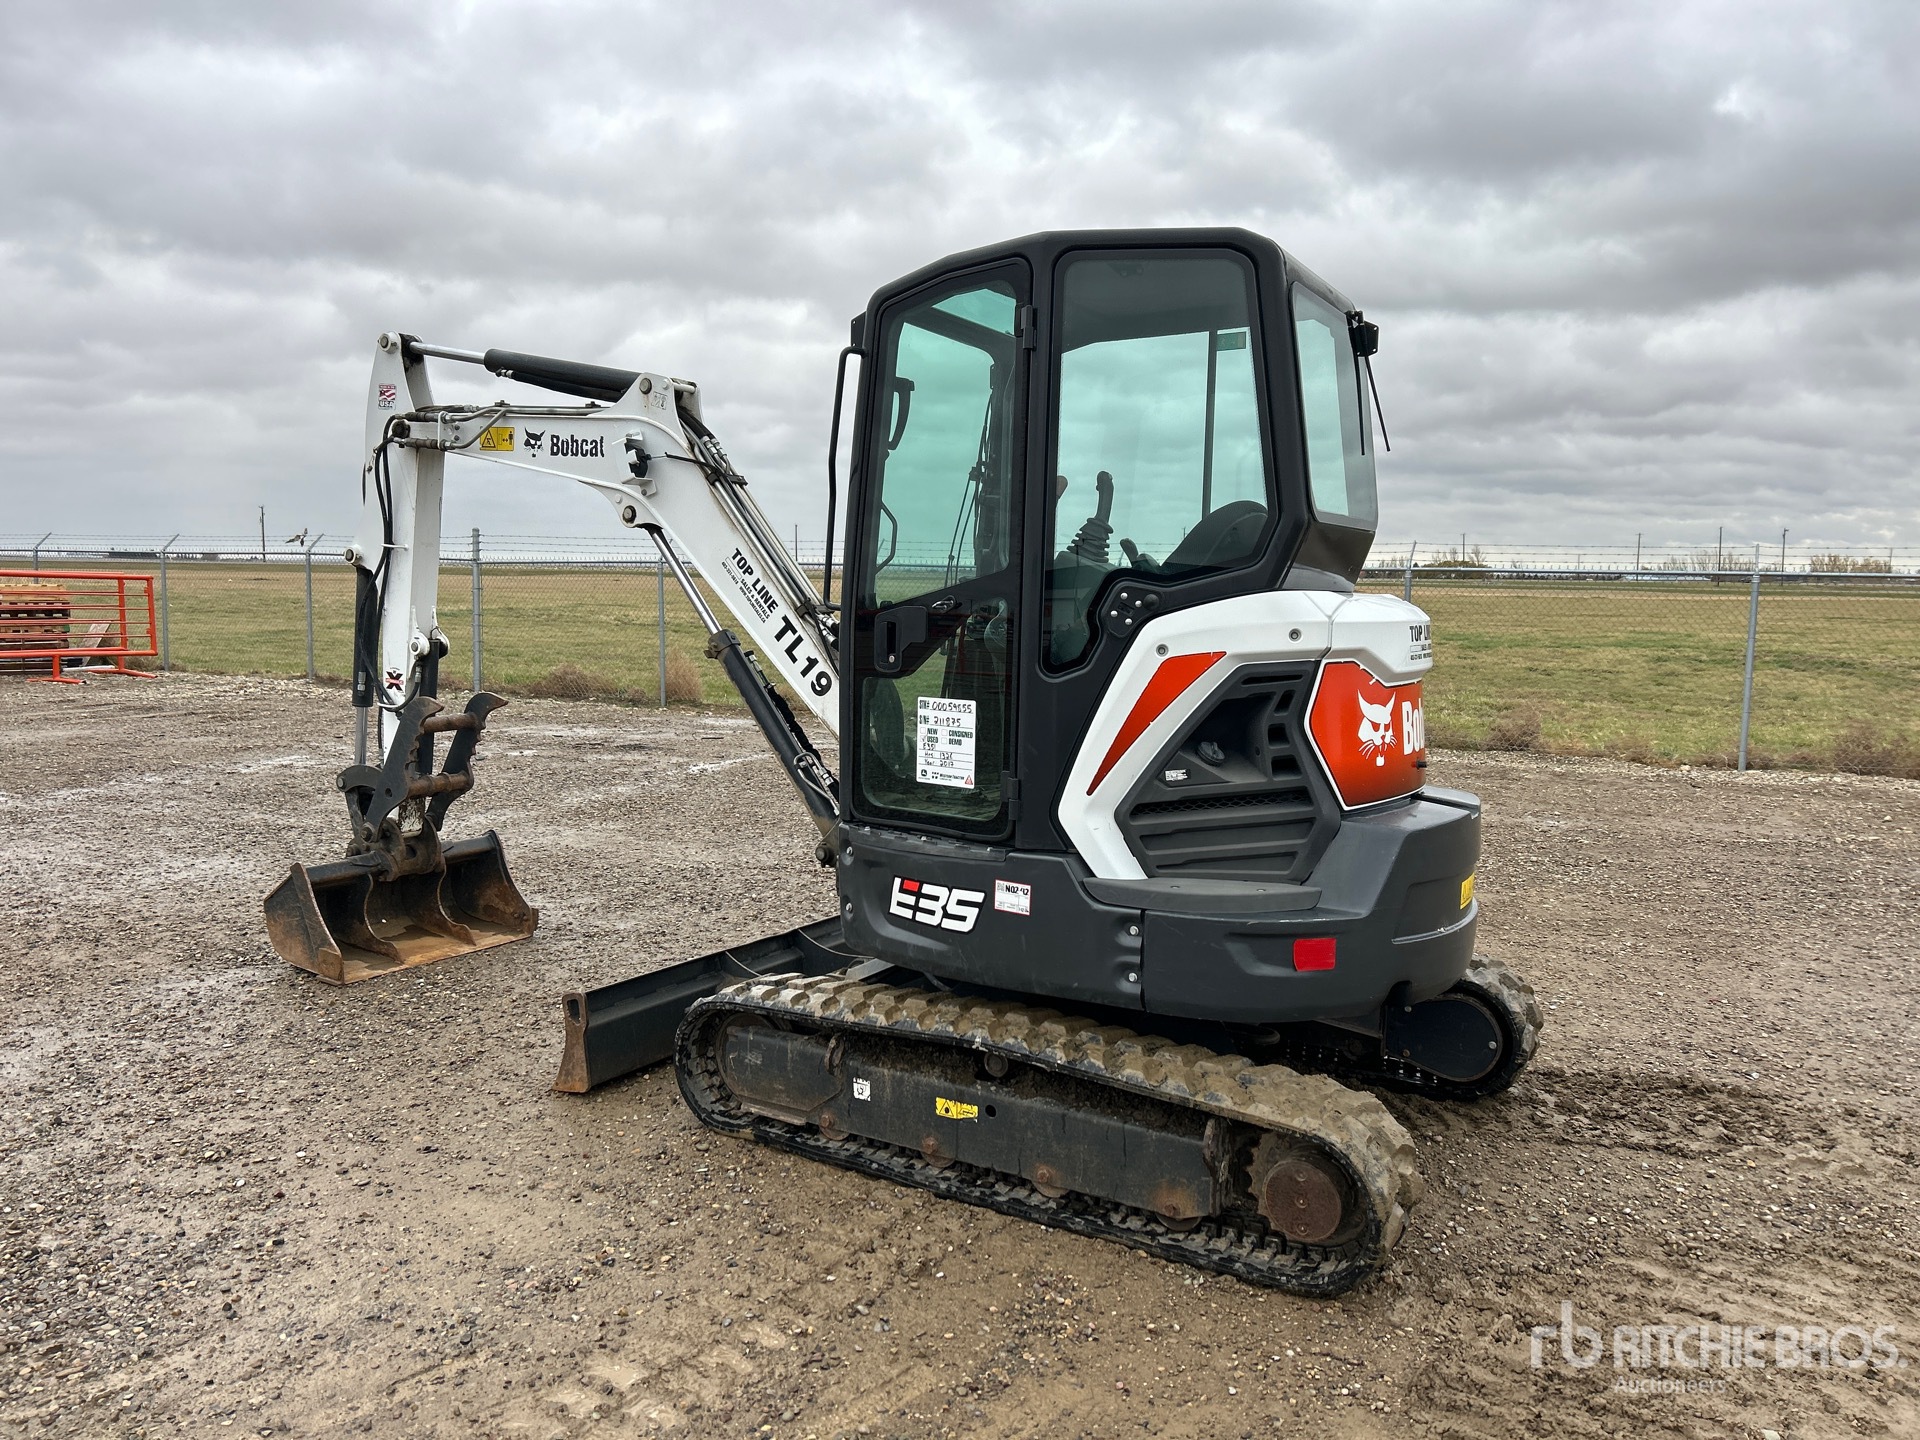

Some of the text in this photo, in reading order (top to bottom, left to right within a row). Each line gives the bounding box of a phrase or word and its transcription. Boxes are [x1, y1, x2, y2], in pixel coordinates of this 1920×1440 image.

[550, 434, 605, 458] Bobcat
[731, 547, 779, 614] TOP LINE
[740, 578, 753, 595] SALES
[754, 597, 771, 620] RENTALS
[1409, 624, 1423, 642] TOP
[774, 614, 833, 697] TL19
[927, 735, 963, 746] USED DEMO
[948, 729, 973, 739] CONSIGNED
[889, 876, 985, 933] E35
